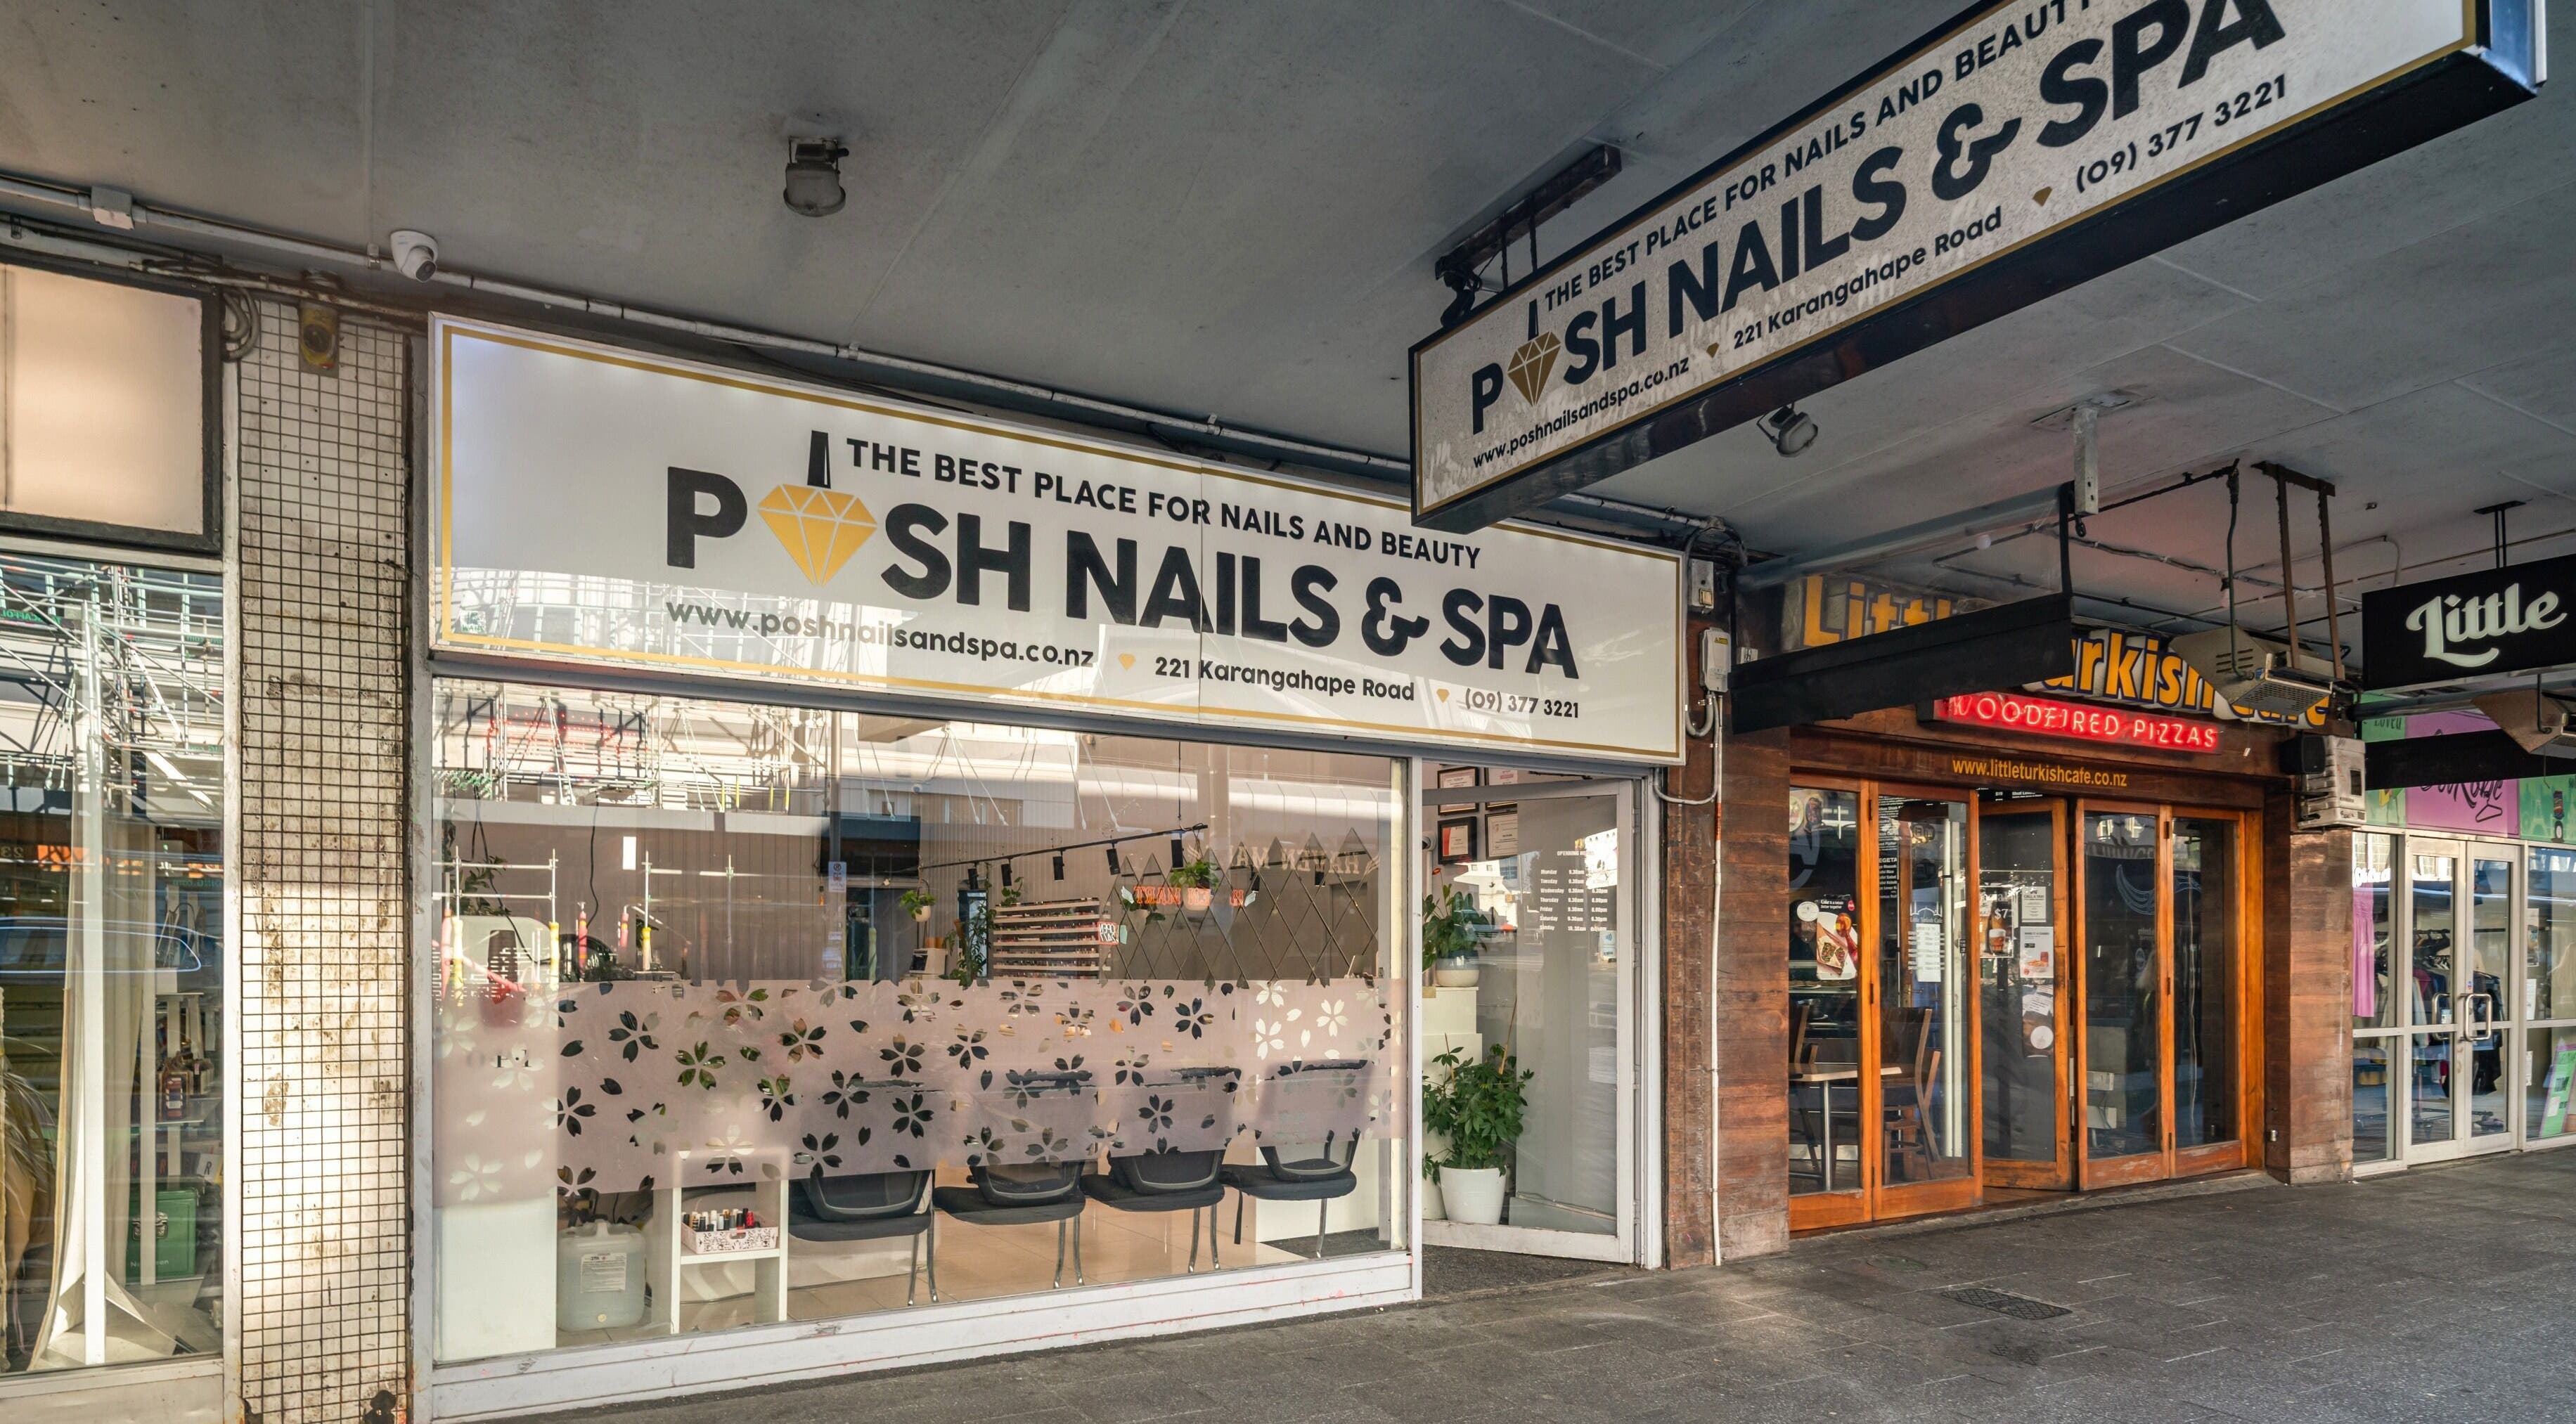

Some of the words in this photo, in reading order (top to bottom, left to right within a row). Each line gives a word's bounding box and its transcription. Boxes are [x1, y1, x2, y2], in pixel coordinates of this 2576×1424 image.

[1545, 274, 1582, 311] THE
[1589, 240, 1639, 288] BEST
[1647, 196, 1717, 256] PLACE
[1726, 164, 1776, 211] FOR
[1786, 112, 1866, 178] NAILS
[1876, 70, 1943, 127] AND
[1956, 0, 2089, 82] BEAUT
[1668, 146, 1906, 339] NAILS
[1932, 103, 2021, 200] &
[2037, 0, 2285, 147] SPA
[1473, 357, 1689, 468] www.poshnailsandspa.co.nz
[1734, 321, 1762, 349] 221
[1769, 248, 1926, 333] Karangahape
[1936, 206, 2002, 257] Road
[2076, 142, 2137, 193] (09)
[2148, 112, 2204, 157] 377
[2215, 75, 2285, 127] 3221
[847, 438, 921, 478] THE
[935, 454, 1022, 494] BEST
[1035, 472, 1137, 514] PLACE
[1149, 491, 1211, 525] FOR
[1222, 503, 1305, 541] NAILS
[1314, 520, 1372, 551] AND
[1382, 531, 1481, 570] BEAUTY
[666, 602, 1094, 667] www.poshnailsandspa.co.nz
[1155, 657, 1190, 678] 221
[1200, 659, 1355, 697] Karangahape
[1363, 679, 1414, 701] Road
[1465, 688, 1502, 713] (09)
[1507, 695, 1538, 713] 377
[1543, 699, 1578, 718] 3221
[1067, 529, 1341, 648] NAILS
[1361, 576, 1430, 656] &
[1440, 588, 1579, 680] SPA
[2405, 583, 2568, 668] Little
[1952, 759, 2127, 787] www.littleturkishcafe.co.nz
[2133, 720, 2216, 747] PIZZAS
